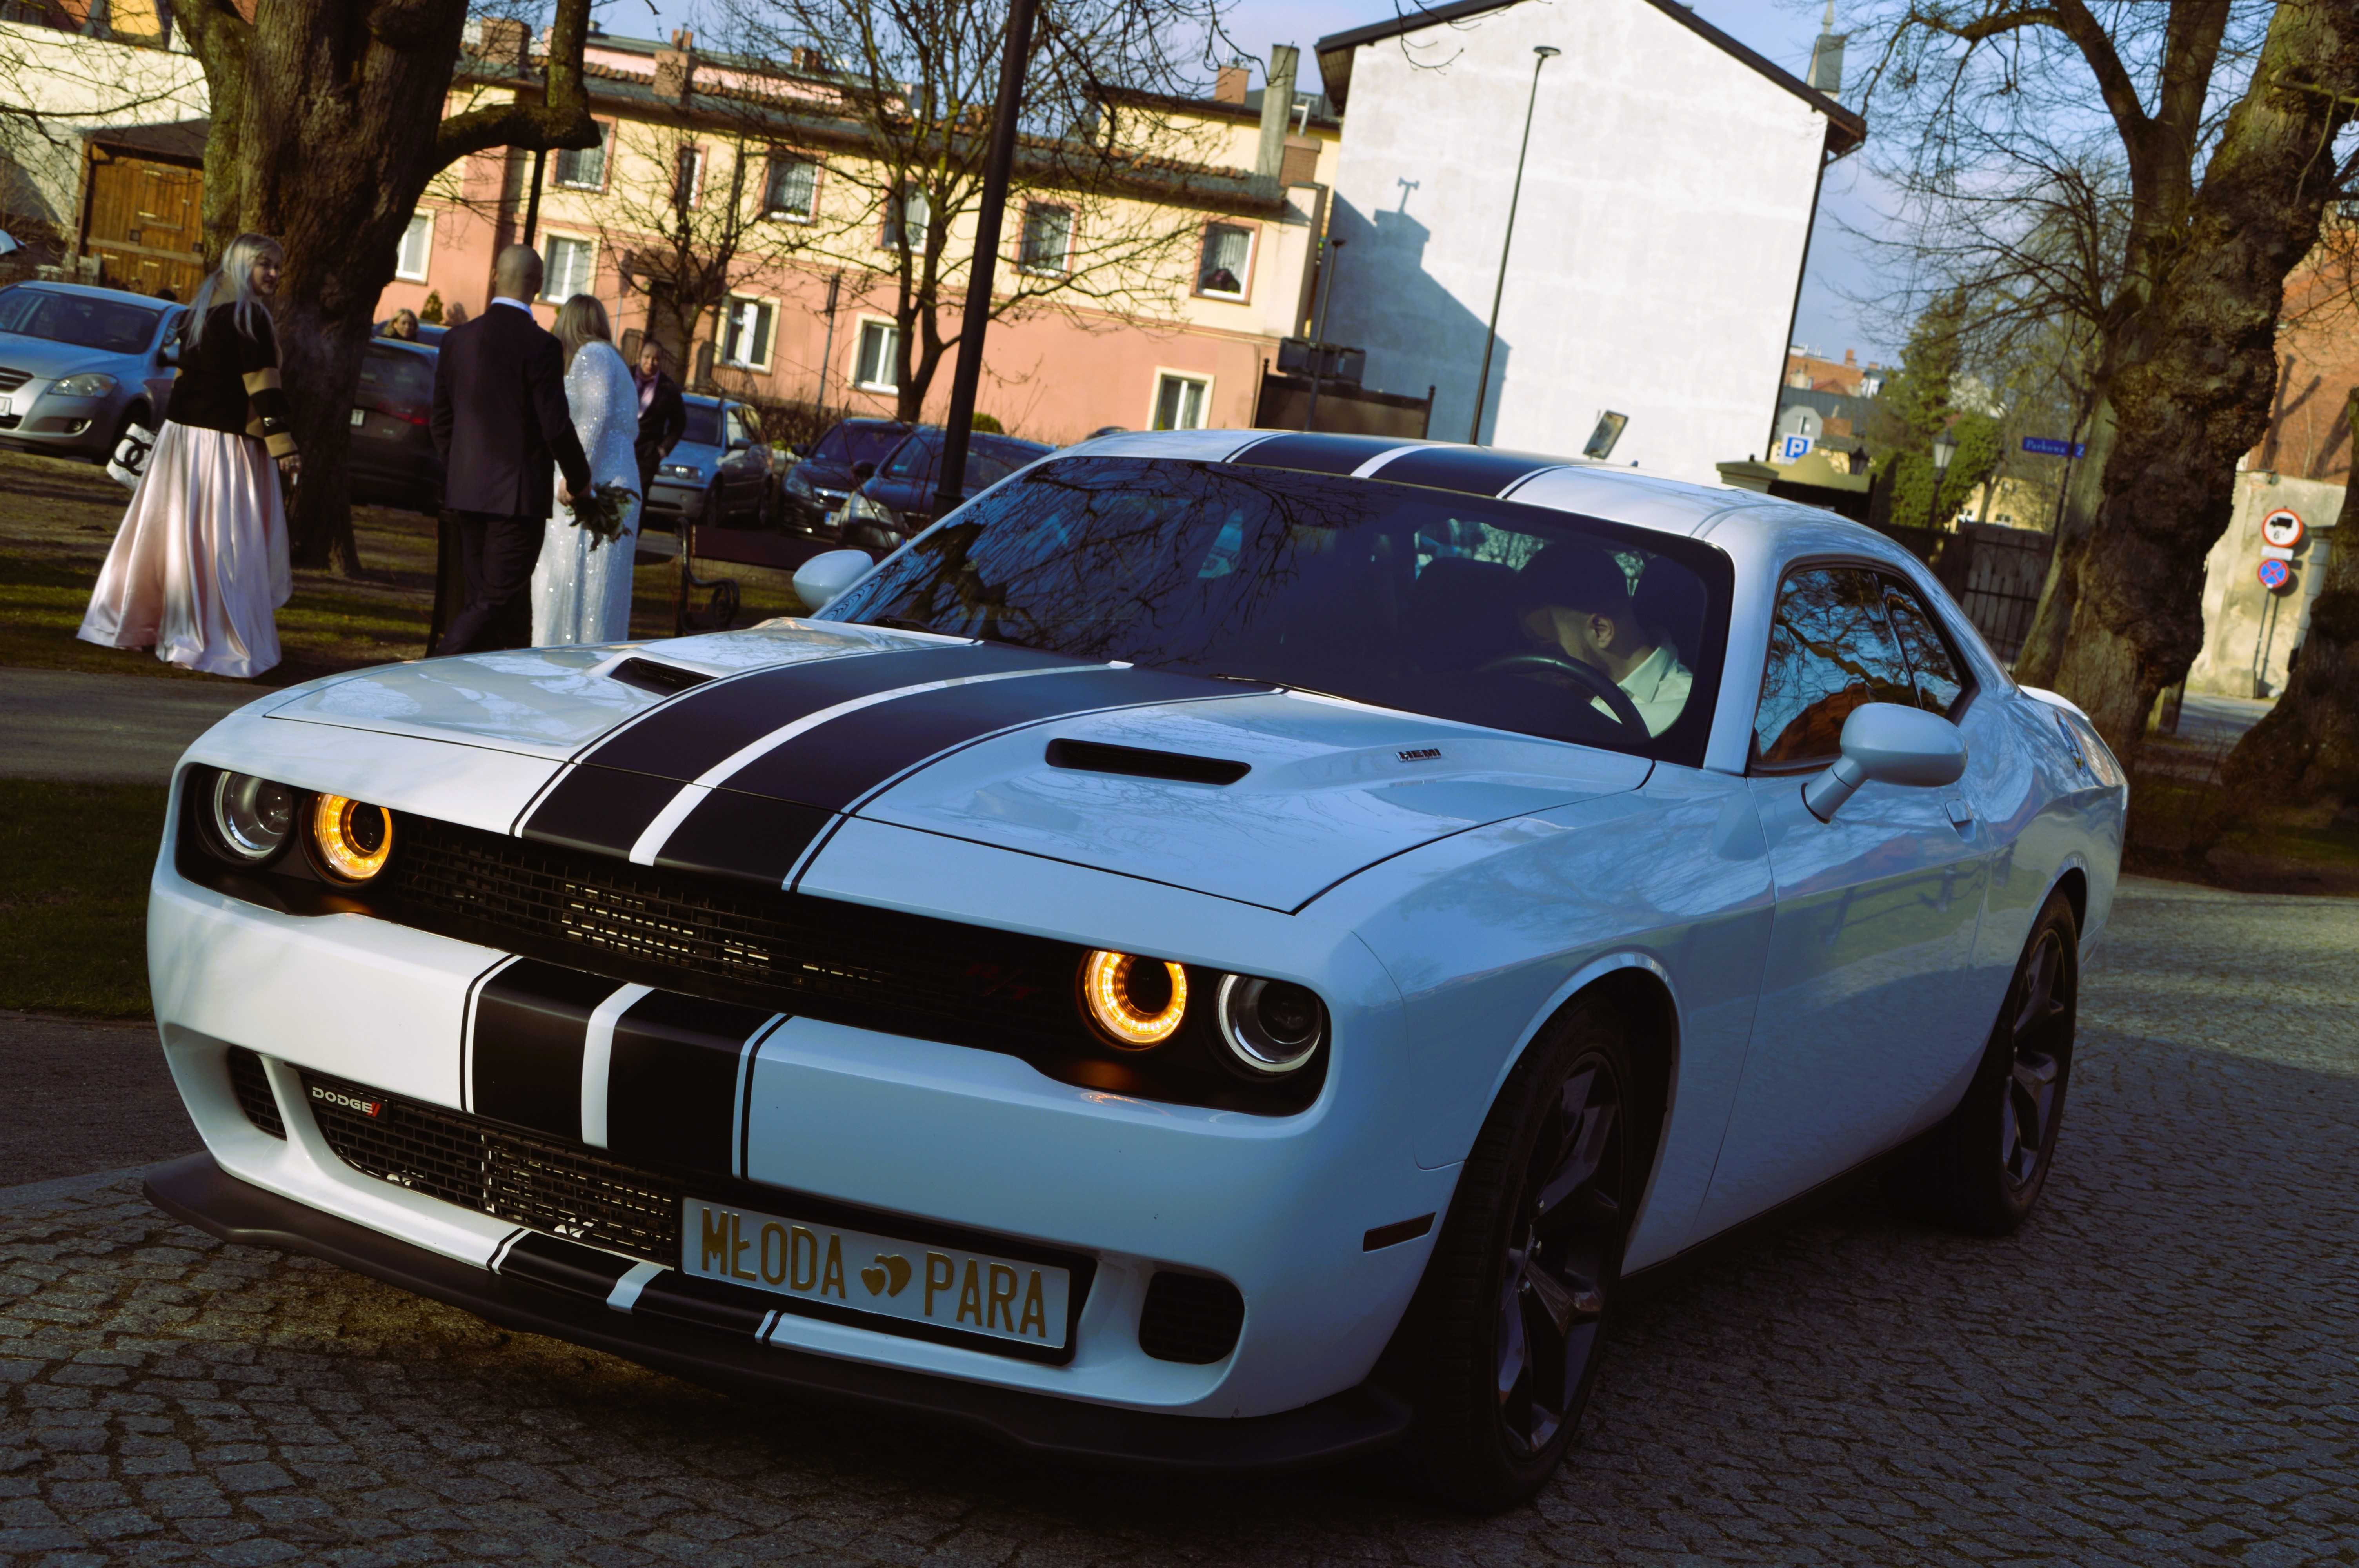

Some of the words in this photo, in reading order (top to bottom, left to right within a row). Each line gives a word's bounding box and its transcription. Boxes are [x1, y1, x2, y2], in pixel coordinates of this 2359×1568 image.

[1788, 439, 1805, 456] P
[1395, 748, 1442, 762] HEMI
[312, 1086, 373, 1114] DODGE
[701, 1207, 846, 1299] MŁODA
[923, 1251, 1046, 1338] PARA
